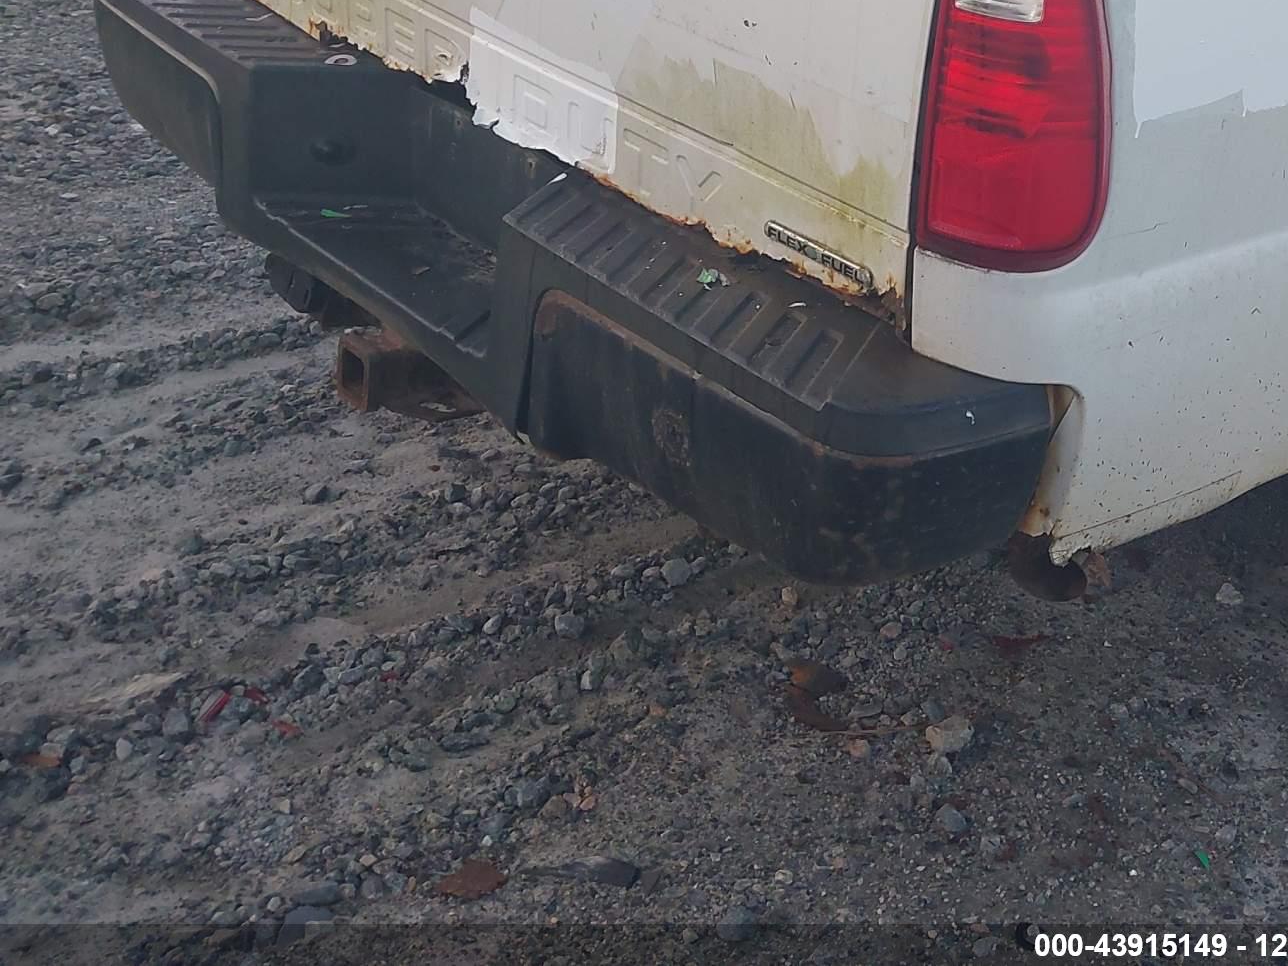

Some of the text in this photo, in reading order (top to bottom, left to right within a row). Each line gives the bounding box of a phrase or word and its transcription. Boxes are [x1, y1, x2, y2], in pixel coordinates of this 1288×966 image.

[512, 73, 722, 212] DUTY
[767, 225, 868, 285] FLEX FUEL
